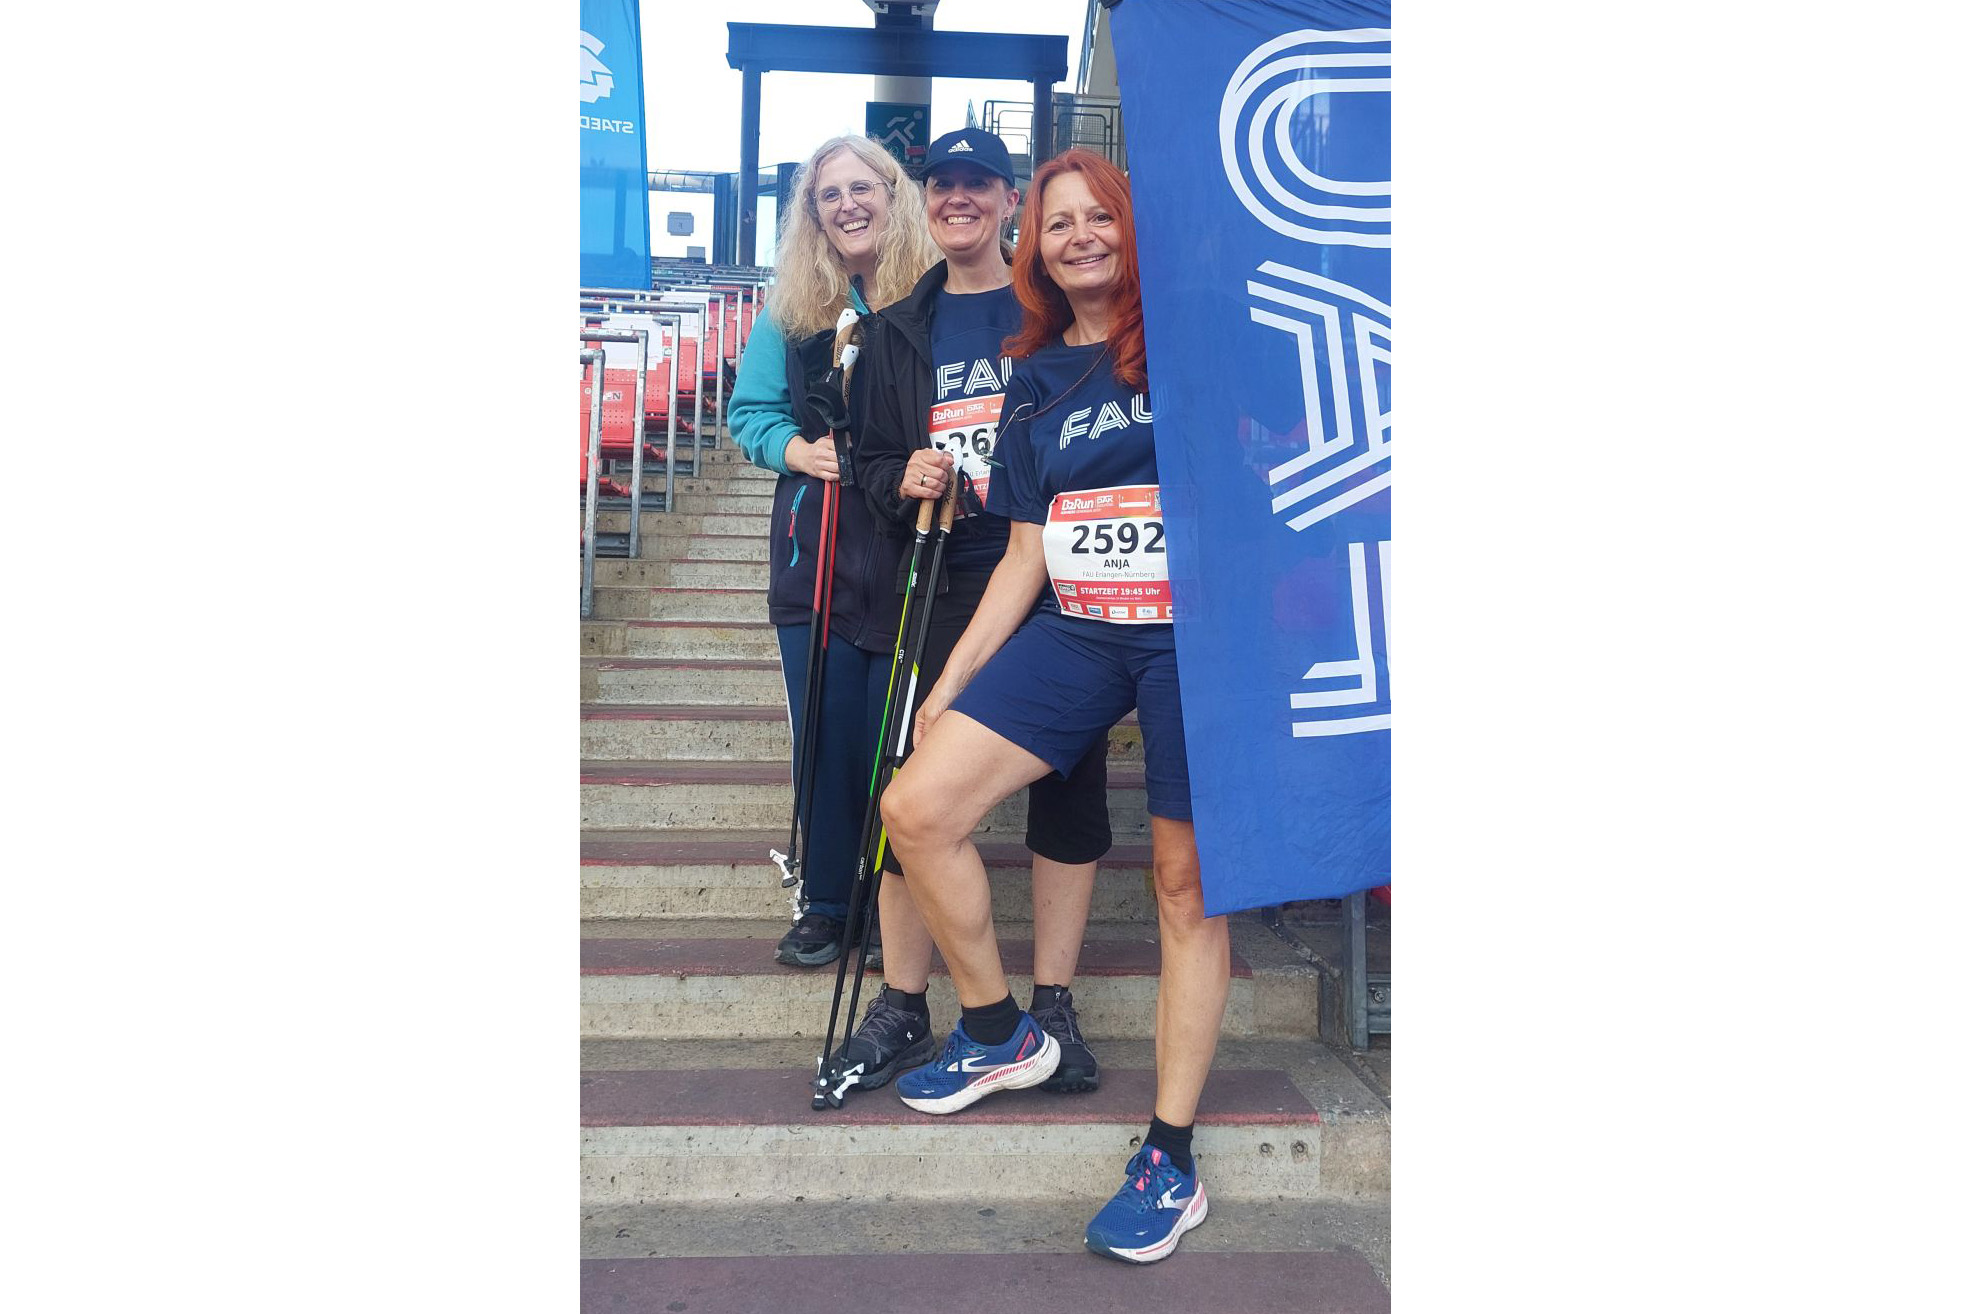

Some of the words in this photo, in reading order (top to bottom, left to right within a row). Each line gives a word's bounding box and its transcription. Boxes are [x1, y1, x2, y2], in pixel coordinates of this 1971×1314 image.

[1071, 522, 1165, 554] 2592
[1103, 559, 1130, 569] ANJA
[1080, 587, 1118, 595] STARTZEIT
